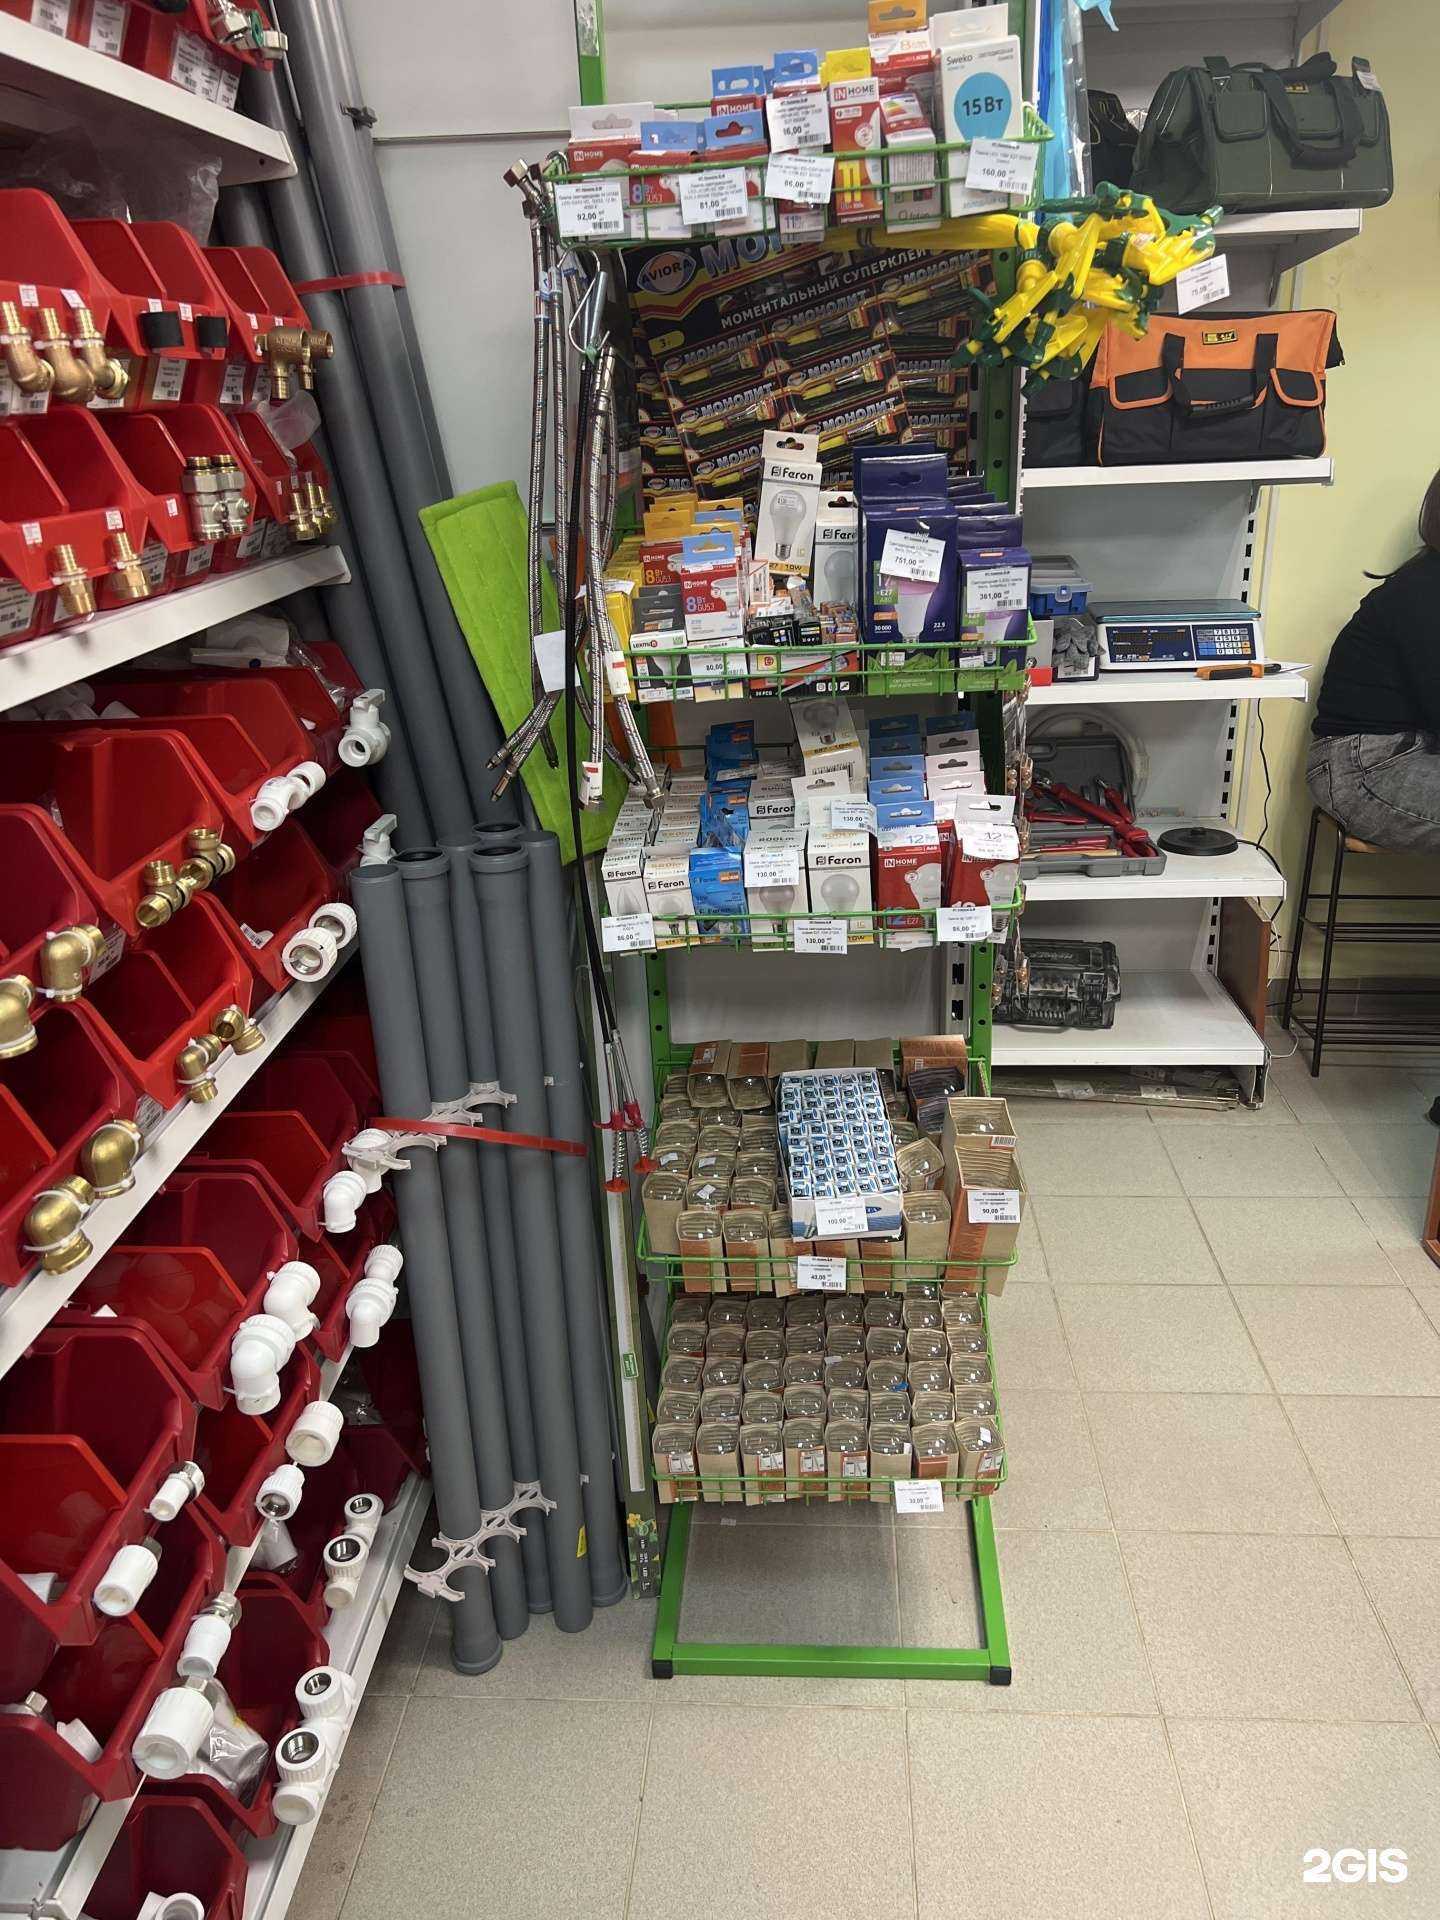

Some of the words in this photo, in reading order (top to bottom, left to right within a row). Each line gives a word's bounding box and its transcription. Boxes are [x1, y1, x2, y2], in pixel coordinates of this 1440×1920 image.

[946, 54, 973, 66] Sweko
[834, 87, 847, 101] IN
[848, 84, 874, 95] HOME
[963, 98, 981, 117] 15
[984, 96, 1003, 113] Вт
[837, 160, 862, 203] 11
[641, 258, 693, 285] AVIORA
[720, 274, 841, 330] МОМЕНТАЛЬНЫЙ
[805, 343, 882, 378] МОНОЛИТ
[700, 382, 773, 418] МОНОЛИТ
[822, 397, 897, 434] МОНОЛИТ
[782, 467, 814, 480] Feron
[645, 569, 655, 584] 8
[686, 596, 697, 612] 8
[828, 855, 862, 865] Feron
[885, 859, 896, 868] IN
[615, 870, 637, 878] Feron
[657, 880, 685, 888] Feron
